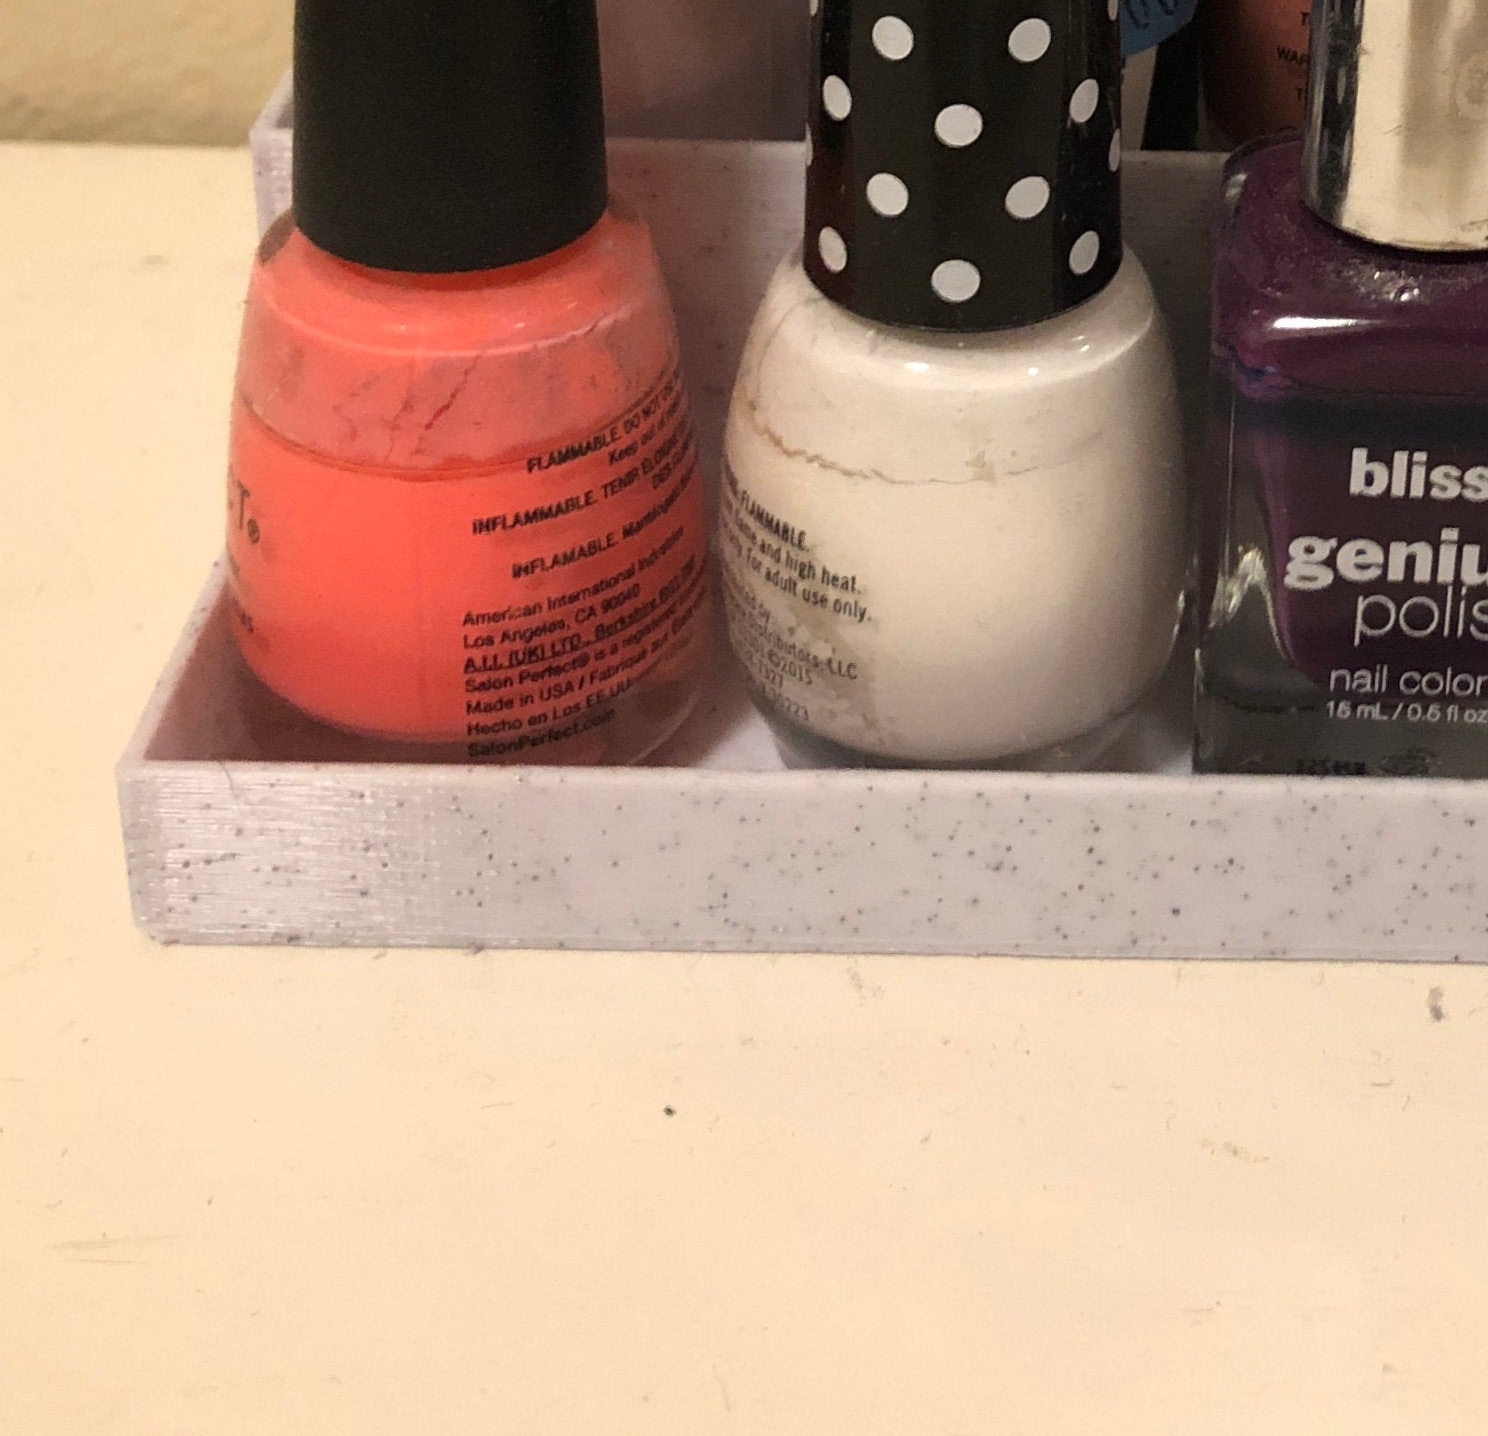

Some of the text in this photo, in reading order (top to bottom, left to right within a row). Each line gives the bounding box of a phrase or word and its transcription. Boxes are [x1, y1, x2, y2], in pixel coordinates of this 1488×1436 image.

[741, 489, 811, 553] FLAMMABLE.
[759, 538, 782, 564] and
[786, 550, 817, 581] high
[821, 565, 862, 595] heat.
[462, 601, 543, 627] American
[547, 563, 636, 612] International
[463, 633, 496, 650] Los
[500, 618, 571, 645] Angeles,
[575, 605, 598, 624] CA
[601, 583, 641, 615] 90040
[764, 566, 798, 598] adult
[802, 587, 829, 609] use
[833, 597, 872, 624] only.
[464, 676, 514, 694] Salon
[594, 648, 606, 662] is
[610, 643, 619, 656] a
[1329, 664, 1389, 693] nail
[466, 697, 515, 715] Made
[519, 692, 535, 708] in
[540, 679, 575, 702] USA
[578, 675, 586, 691] /
[467, 717, 524, 737] Hecho
[527, 711, 549, 727] en
[553, 701, 582, 721] Los
[1356, 702, 1388, 721] mL
[1391, 702, 1404, 721] /
[1447, 704, 1460, 723] fl
[467, 707, 617, 758] SalonPerfect.com
